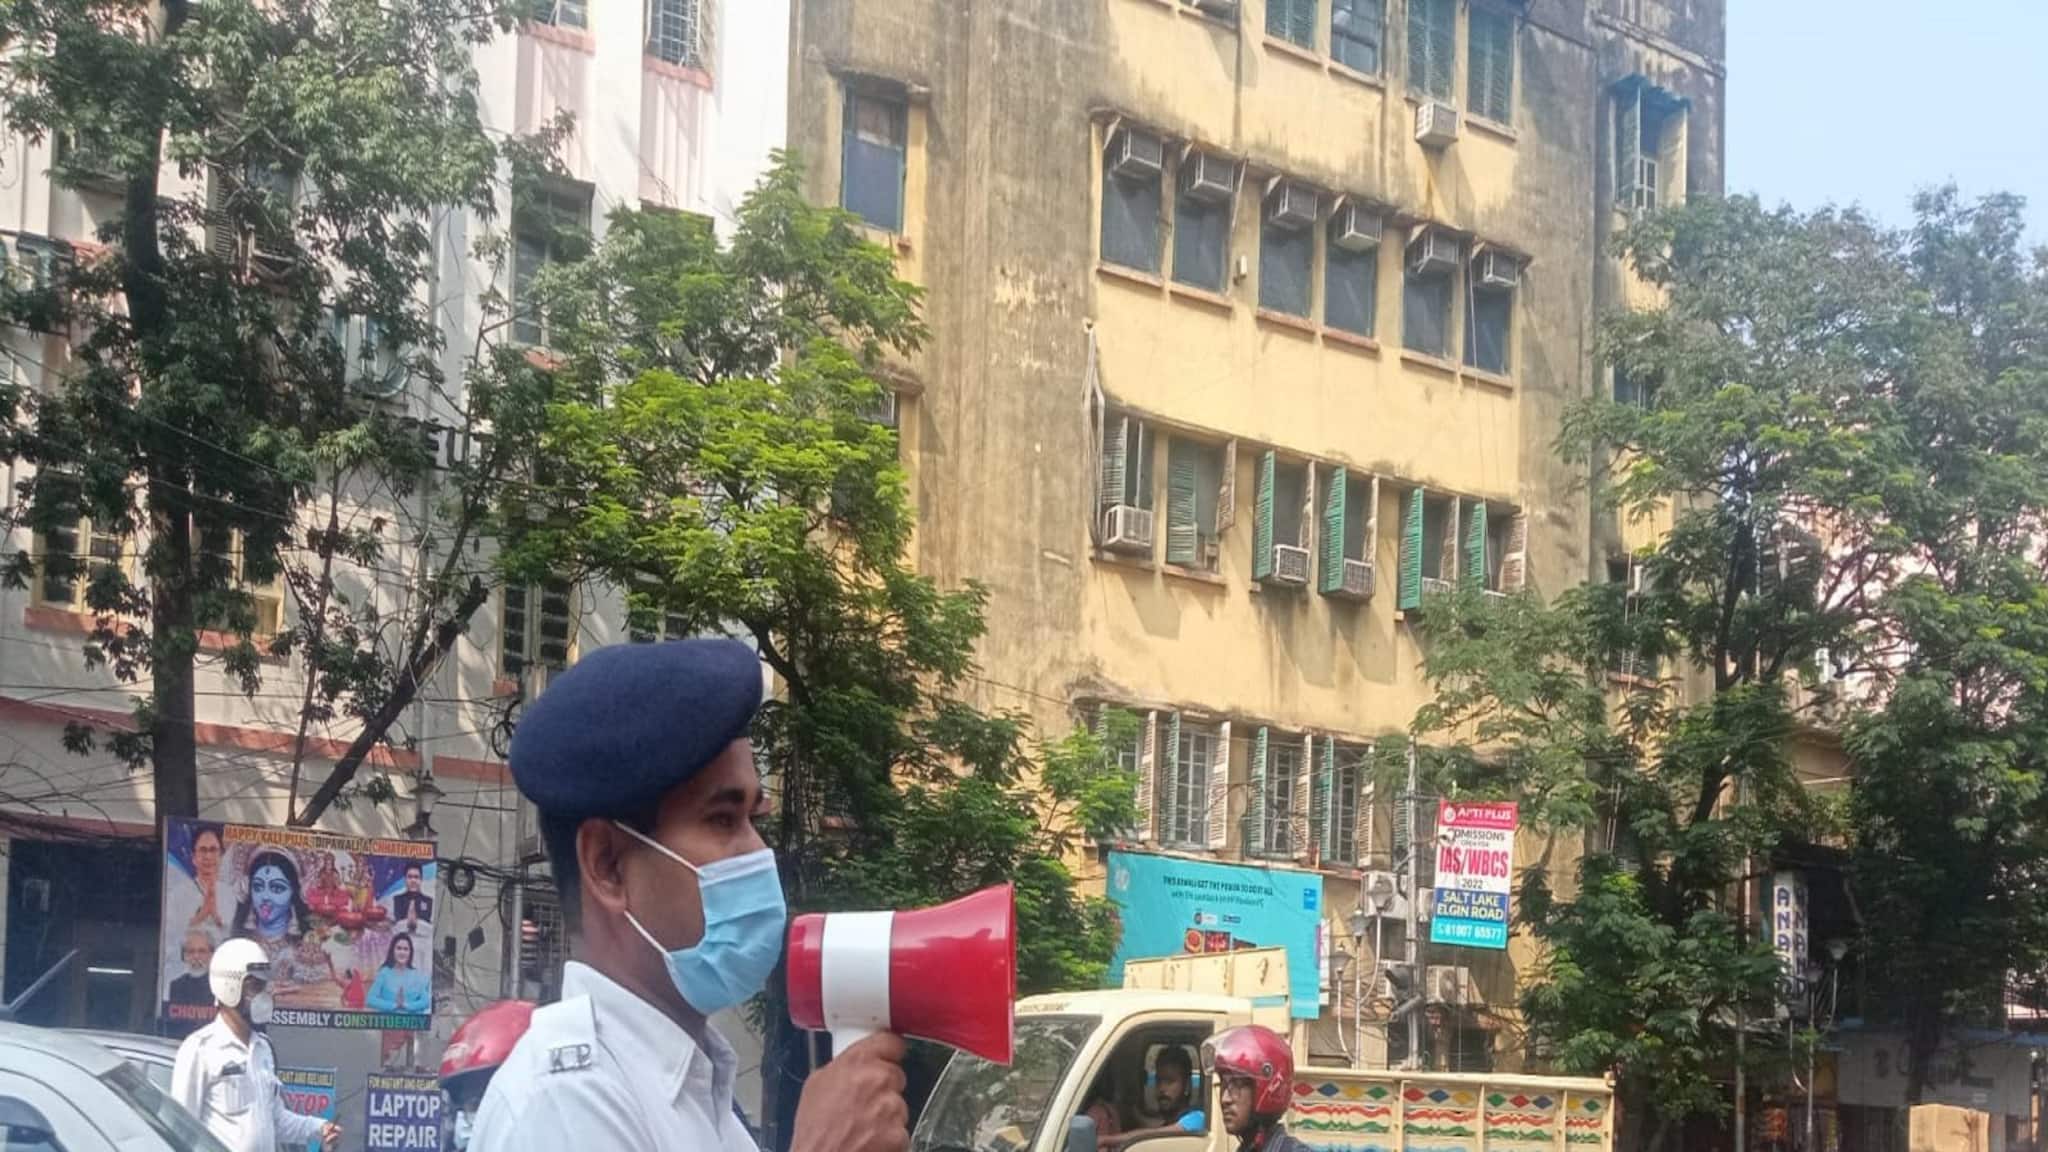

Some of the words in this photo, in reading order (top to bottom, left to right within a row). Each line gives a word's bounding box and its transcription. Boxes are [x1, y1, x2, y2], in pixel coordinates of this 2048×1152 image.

[1484, 808, 1511, 820] PLUS
[224, 826, 258, 843] HAPPY
[1449, 828, 1505, 841] DMISSIONS
[1440, 847, 1509, 878] IAS/WBCS
[1462, 878, 1483, 890] 2022
[1443, 890, 1470, 904] SALT
[1472, 892, 1498, 907] LAKE
[1437, 903, 1470, 917] ELGIN
[1471, 906, 1504, 921] ROAD
[334, 1013, 428, 1031] CONSTITUENCY
[370, 1093, 440, 1119] LAPTOP
[368, 1124, 437, 1149] REPAIR
